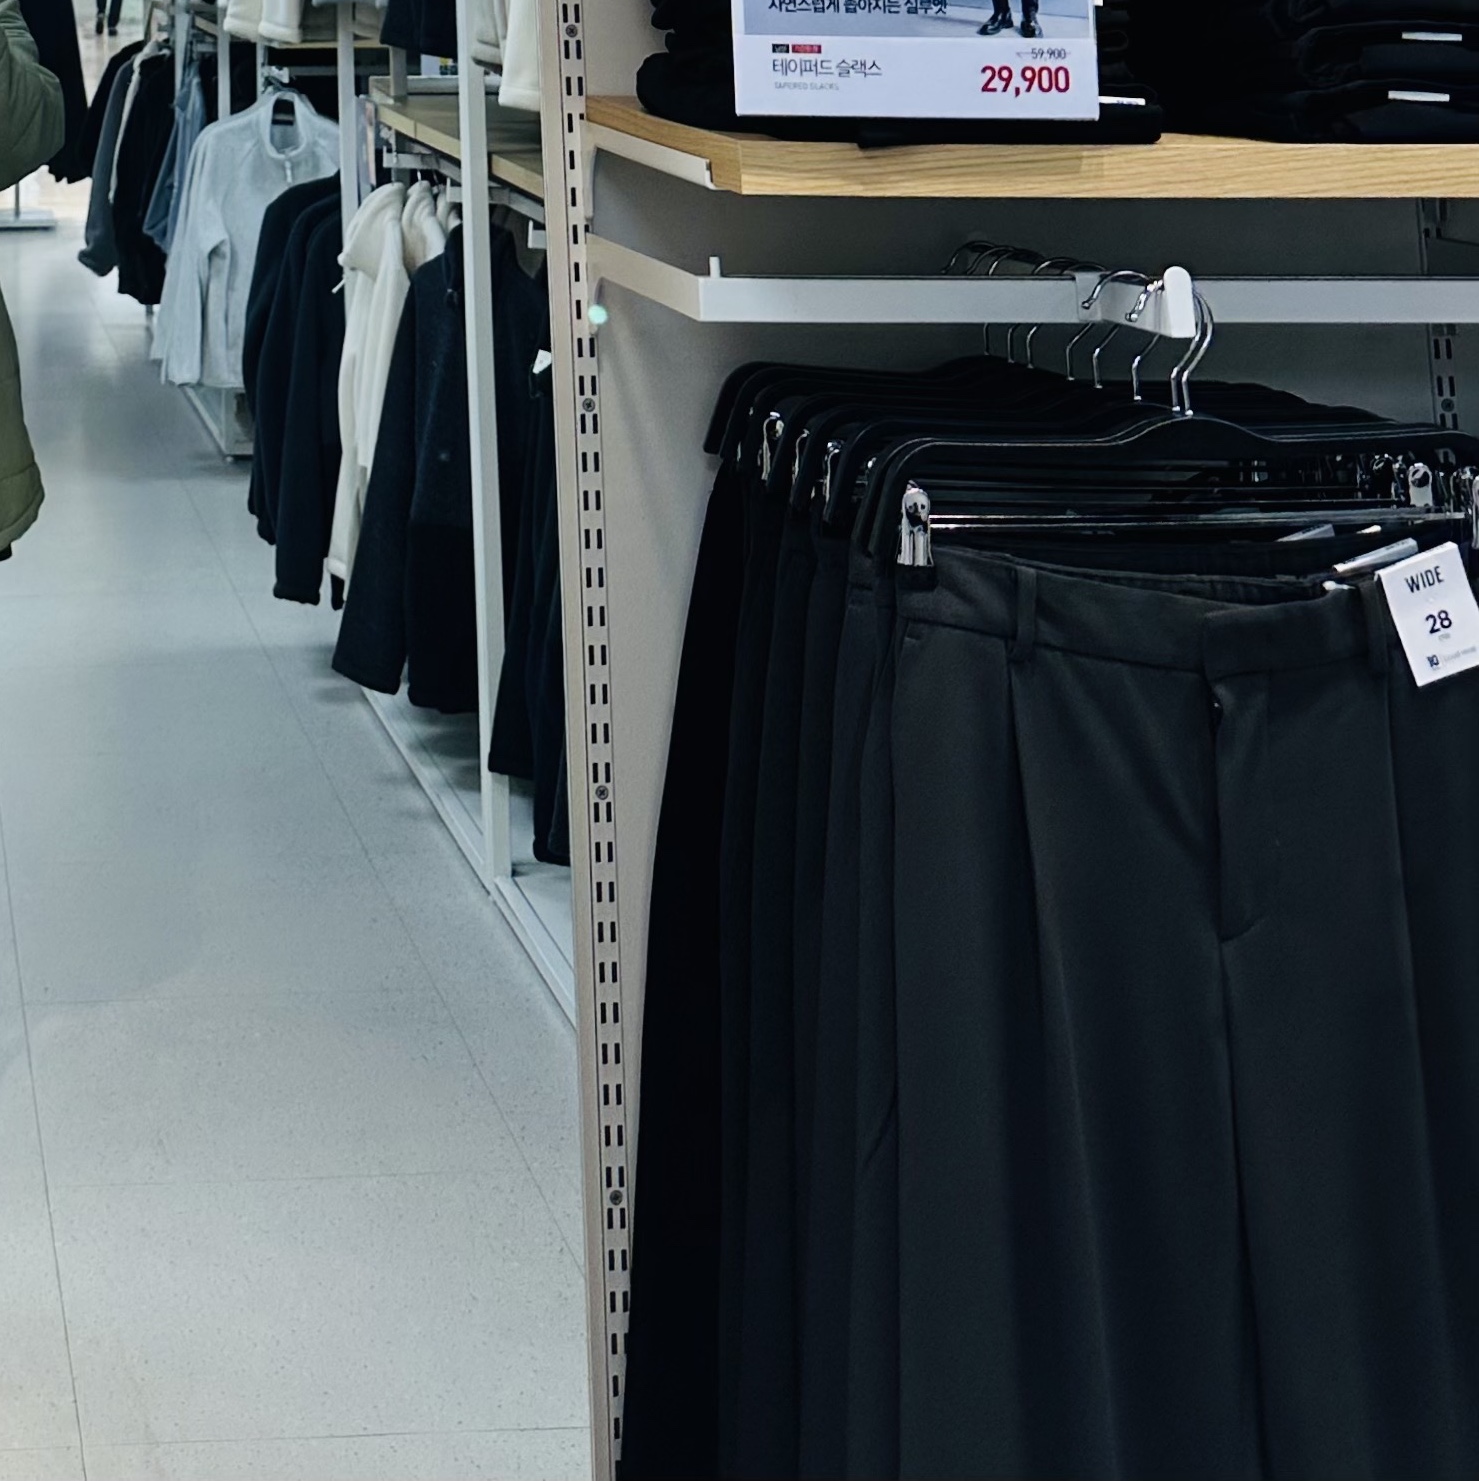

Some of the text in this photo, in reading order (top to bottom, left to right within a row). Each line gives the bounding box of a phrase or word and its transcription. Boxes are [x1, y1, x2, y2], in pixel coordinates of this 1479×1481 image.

[1031, 47, 1067, 62] 59,900
[772, 57, 883, 78] 테이퍼드 슬랙스
[980, 65, 1071, 99] 29,900
[1404, 566, 1444, 593] WIDE
[1425, 610, 1452, 634] 28
